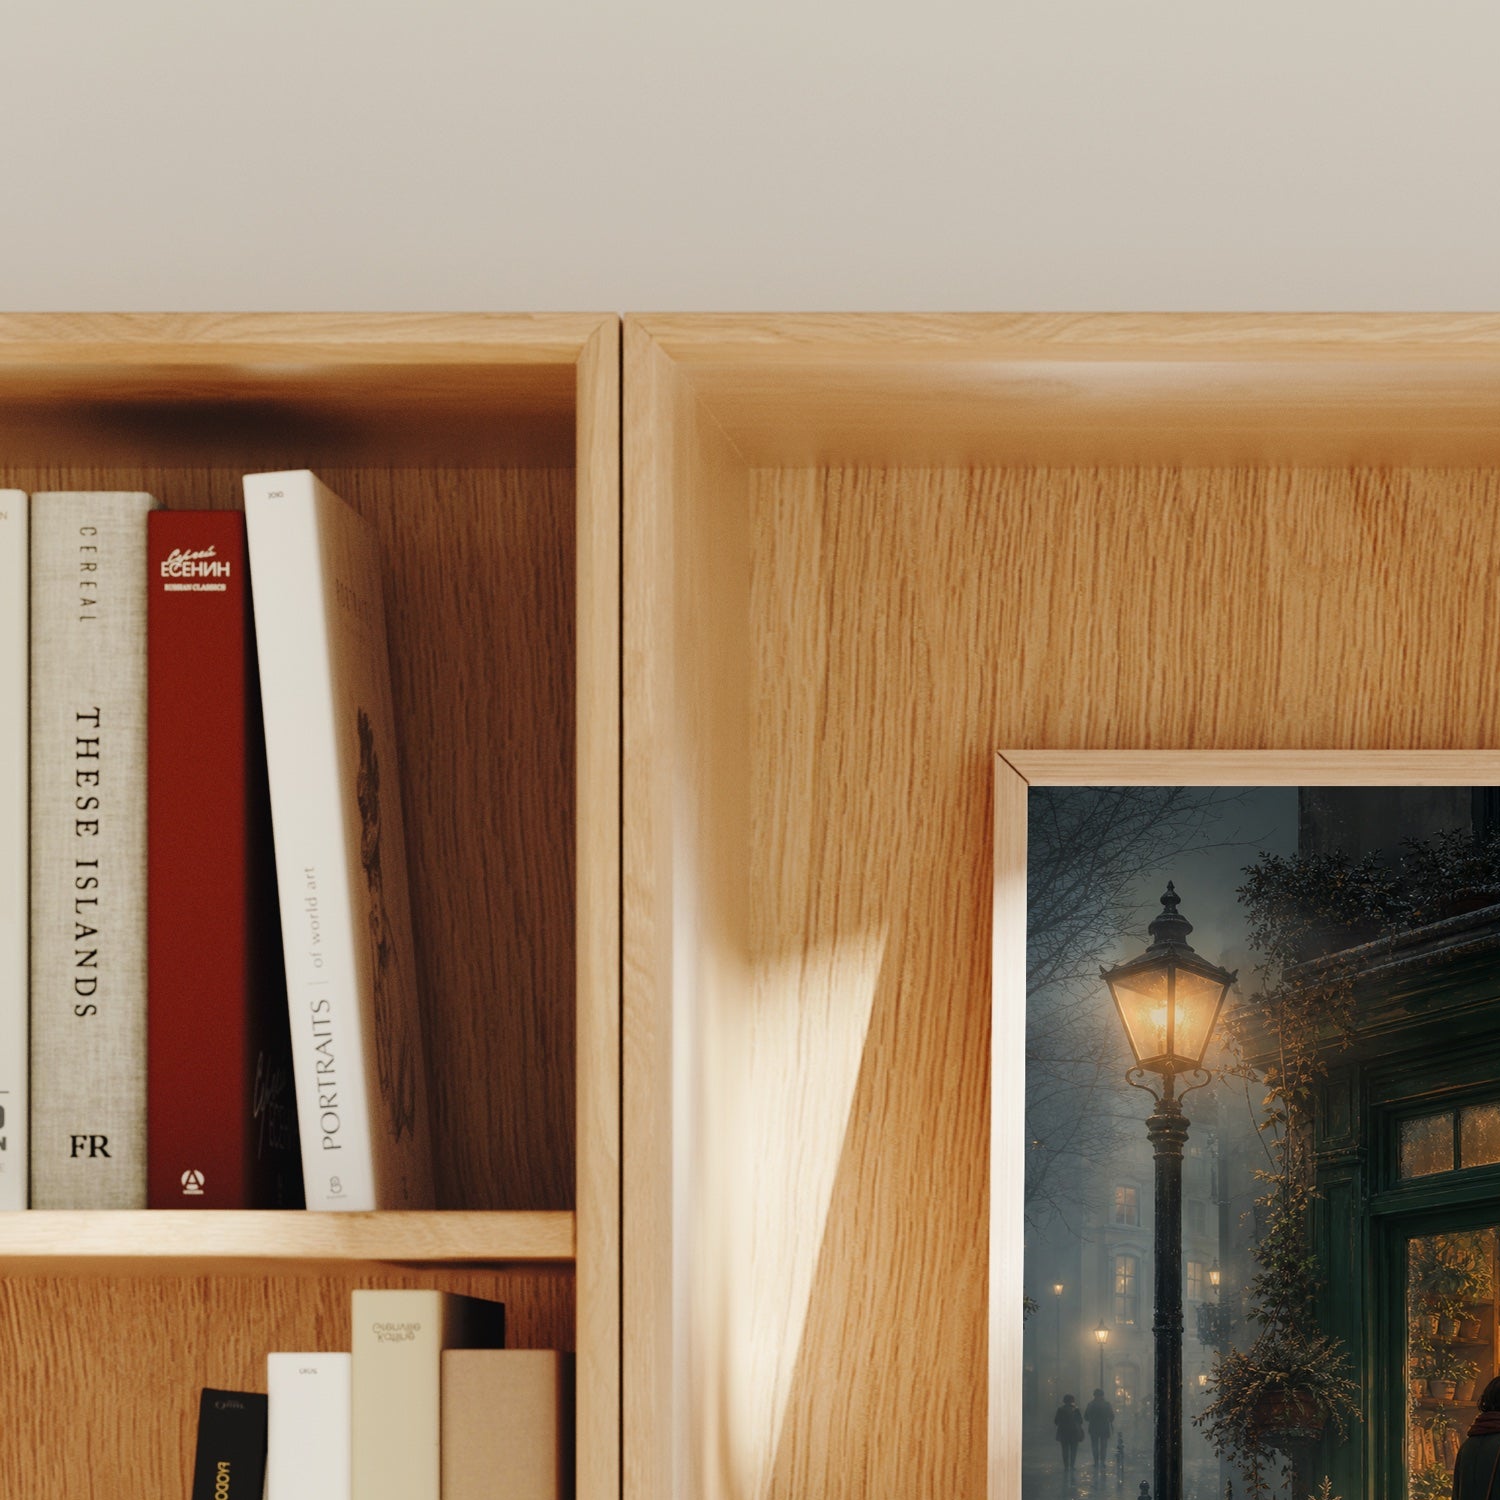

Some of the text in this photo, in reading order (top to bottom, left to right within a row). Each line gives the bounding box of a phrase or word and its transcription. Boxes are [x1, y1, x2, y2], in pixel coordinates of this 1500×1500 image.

[79, 526, 97, 622] CEREAL
[161, 561, 230, 577] ЕСЕНИН
[74, 707, 100, 1017] THESE ISLANDS
[304, 867, 342, 1150] PORTRAITS of world art
[70, 1134, 112, 1158] FR
